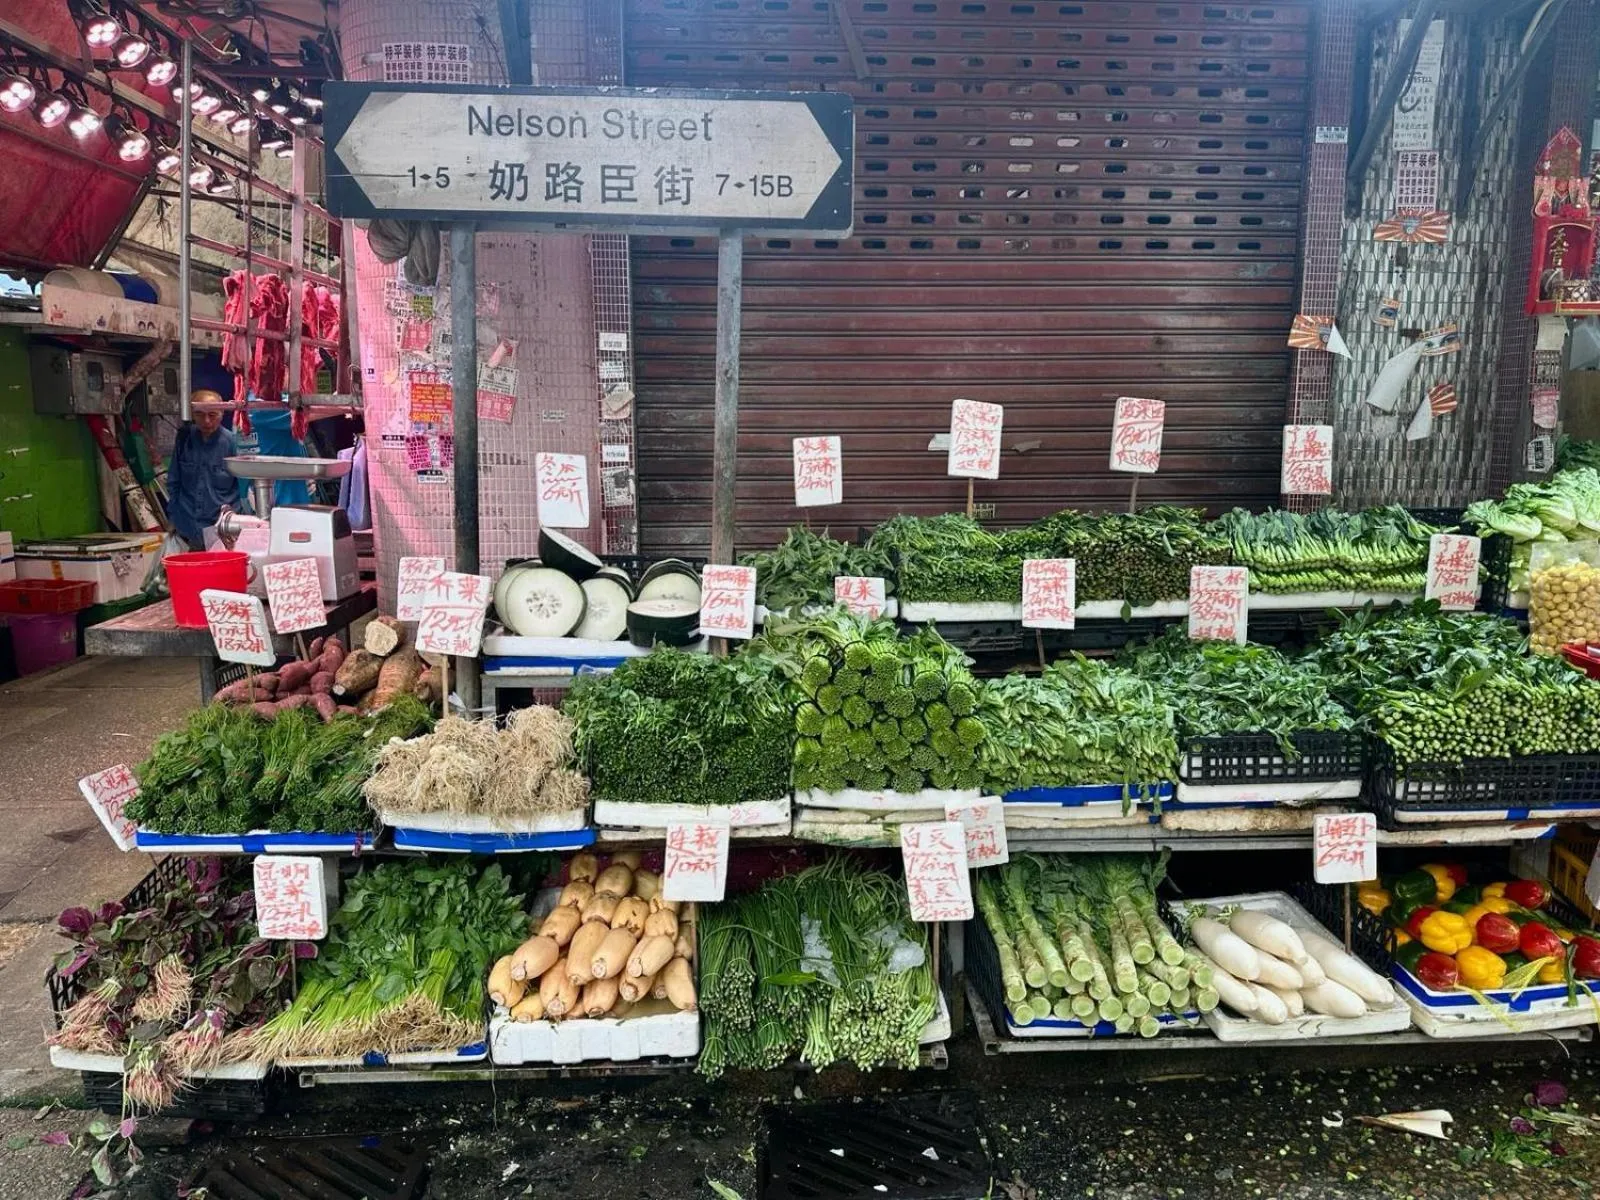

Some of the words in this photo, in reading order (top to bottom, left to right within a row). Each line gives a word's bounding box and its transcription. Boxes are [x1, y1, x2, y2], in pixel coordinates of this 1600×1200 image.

[467, 104, 588, 139] Nelson
[602, 107, 713, 143] Street
[488, 160, 694, 207] 奶路臣街
